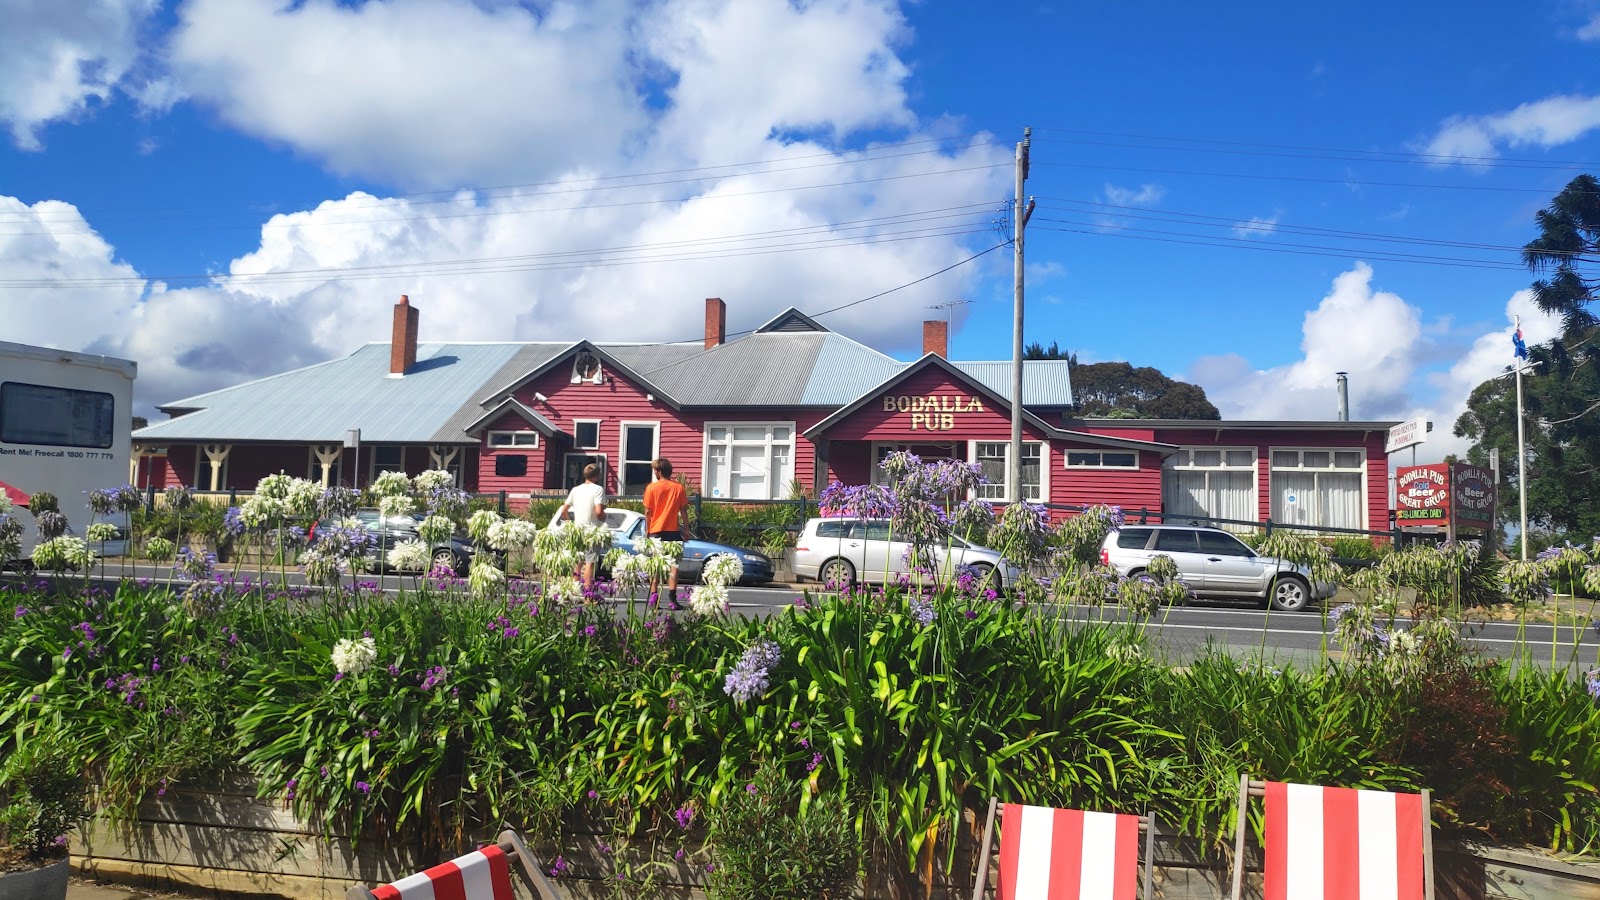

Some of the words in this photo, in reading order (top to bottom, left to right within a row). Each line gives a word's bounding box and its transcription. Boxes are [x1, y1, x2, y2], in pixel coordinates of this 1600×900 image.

[883, 395, 984, 412] BODALLA
[911, 413, 955, 431] PUB
[0, 447, 16, 455] Rent
[18, 448, 32, 456] Me!
[35, 449, 64, 457] Freecall
[1400, 469, 1428, 488] BODALLA
[1430, 470, 1444, 485] PUB
[1413, 481, 1429, 490] Cold
[1457, 469, 1480, 484] BODALLA
[1481, 472, 1492, 488] PUB
[1400, 493, 1421, 508] GREAT
[1424, 489, 1446, 507] GRUB
[1409, 489, 1434, 497] Beer
[1456, 490, 1475, 509] GREAT
[1476, 493, 1493, 509] GRUB
[1464, 487, 1484, 498] Beer
[1430, 509, 1442, 518] DAILY
